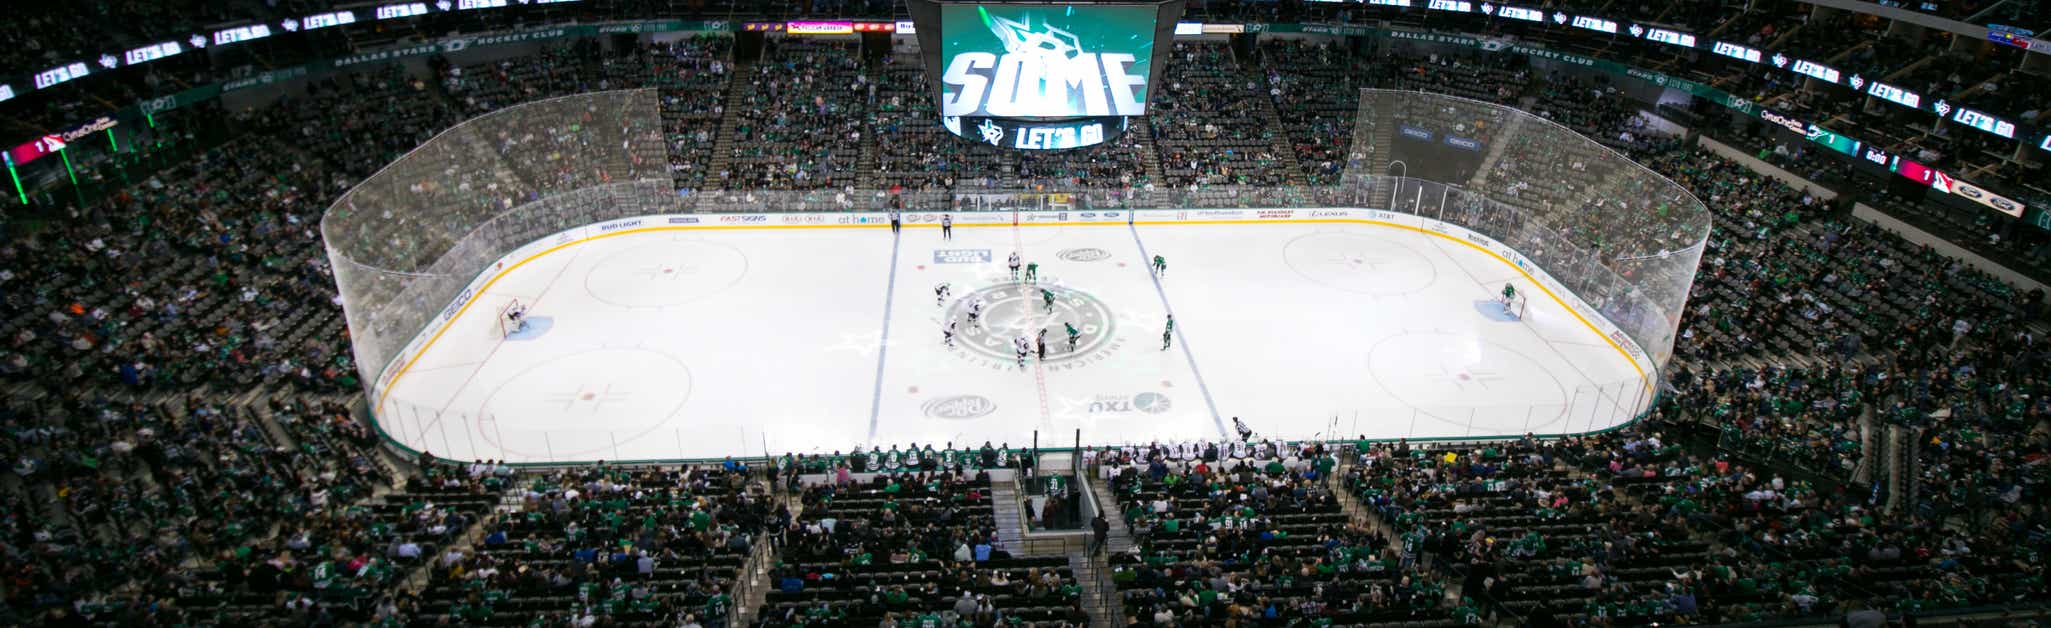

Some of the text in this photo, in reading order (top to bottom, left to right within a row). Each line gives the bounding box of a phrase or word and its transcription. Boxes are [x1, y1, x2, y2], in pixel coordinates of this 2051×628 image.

[377, 4, 410, 19] LET'S
[458, 0, 491, 9] LETS
[1498, 6, 1529, 20] LET'S
[304, 13, 340, 30] LET'S
[1572, 16, 1603, 31] LET'S
[214, 27, 251, 45] LET'S
[478, 29, 564, 45] HOCKEY CLUB
[1391, 31, 1475, 46] DALLAS STARS
[1646, 29, 1680, 45] LET'S
[126, 44, 163, 65] LET'S
[335, 45, 436, 66] DALLAS STARS
[1512, 46, 1594, 66] HOCKEY CLUB
[1713, 42, 1746, 60] LET'S
[35, 66, 71, 89] LET'S
[1792, 60, 1825, 80] LET'S
[942, 51, 1146, 116] SOME
[1868, 82, 1903, 103] LET'S
[1953, 108, 1995, 133] LET'S
[1015, 123, 1104, 150] LET'S GO
[1829, 134, 1835, 144] 1
[35, 141, 44, 152] 1
[1866, 150, 1887, 165] 0:00
[1923, 170, 1930, 181] 1
[602, 220, 641, 231] BUD LIGHT
[838, 214, 884, 224] at home
[1502, 248, 1512, 259] at
[443, 289, 472, 321] GEICO
[1089, 402, 1131, 412] TXU
